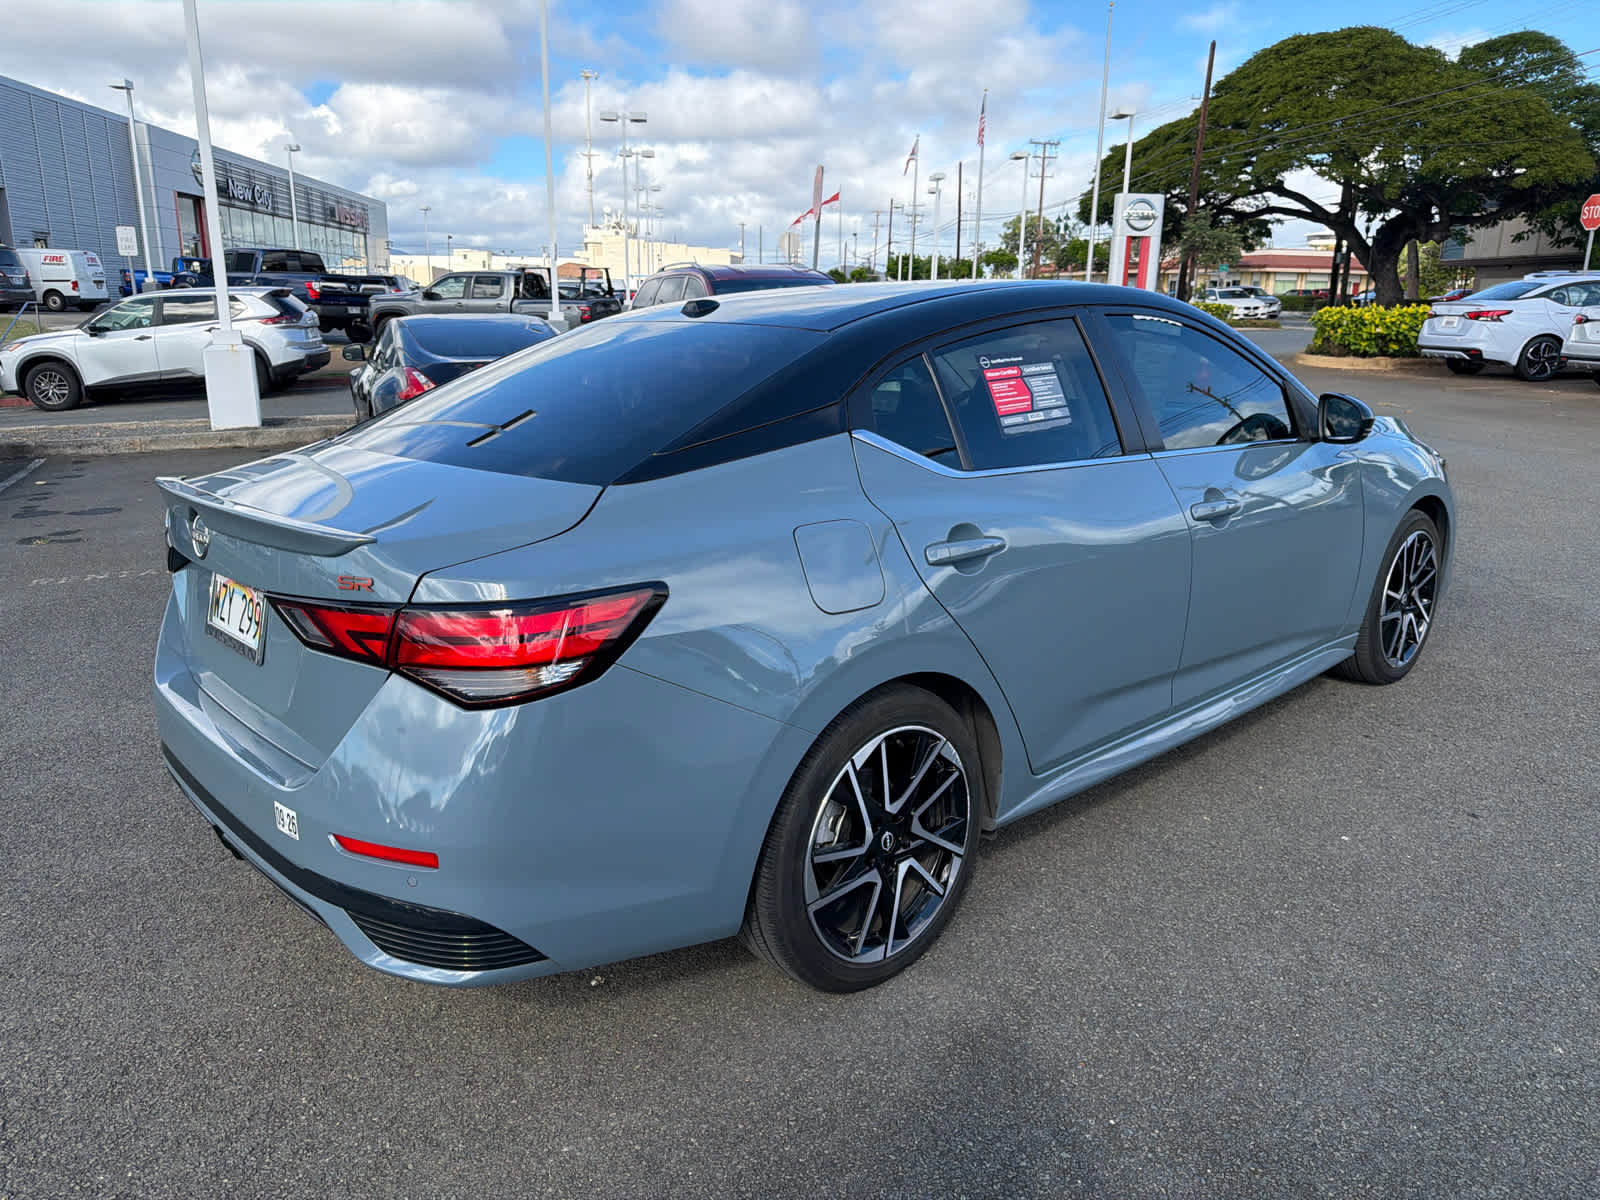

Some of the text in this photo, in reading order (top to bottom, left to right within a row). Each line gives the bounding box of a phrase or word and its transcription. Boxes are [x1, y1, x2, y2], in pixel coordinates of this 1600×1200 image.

[228, 177, 273, 210] New City
[1582, 206, 1600, 219] STO
[336, 575, 374, 592] SR
[239, 593, 262, 640] 299
